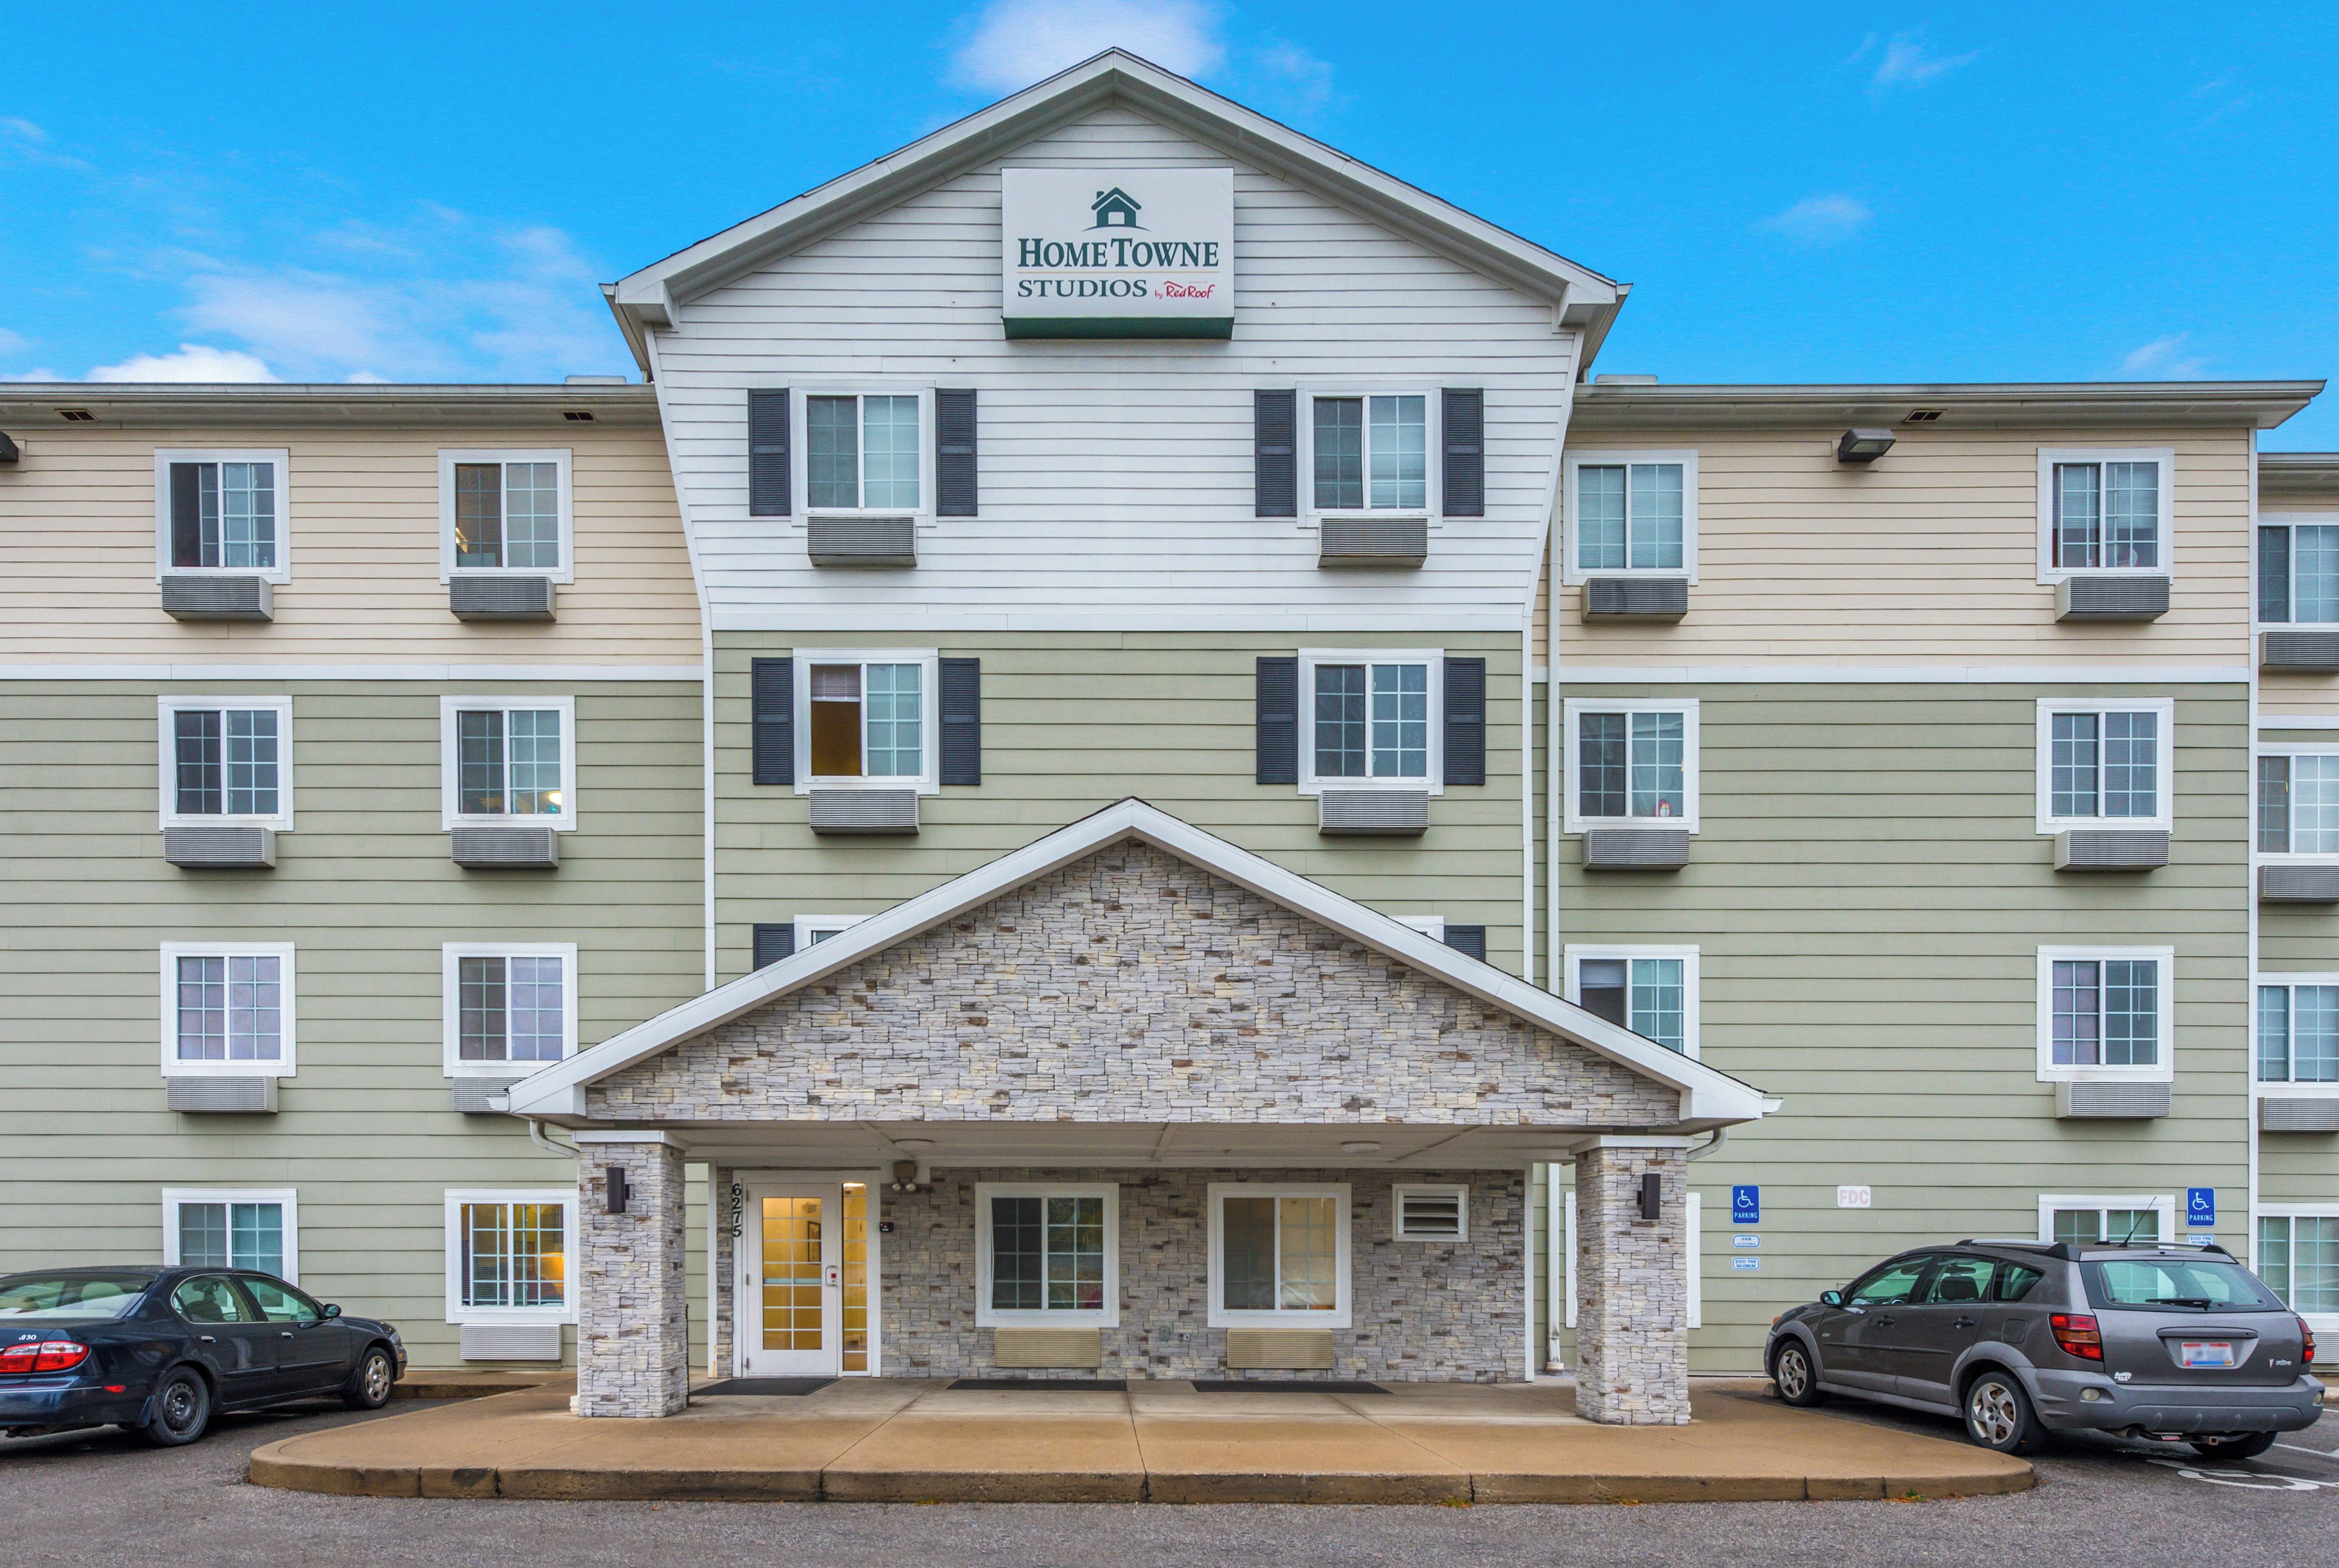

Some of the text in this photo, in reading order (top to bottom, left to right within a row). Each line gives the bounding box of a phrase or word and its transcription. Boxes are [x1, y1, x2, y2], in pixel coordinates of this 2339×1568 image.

[1018, 279, 1148, 298] STUDIOS
[1155, 289, 1163, 300] by
[1839, 1189, 1869, 1204] FDC
[732, 1183, 742, 1237] 6275
